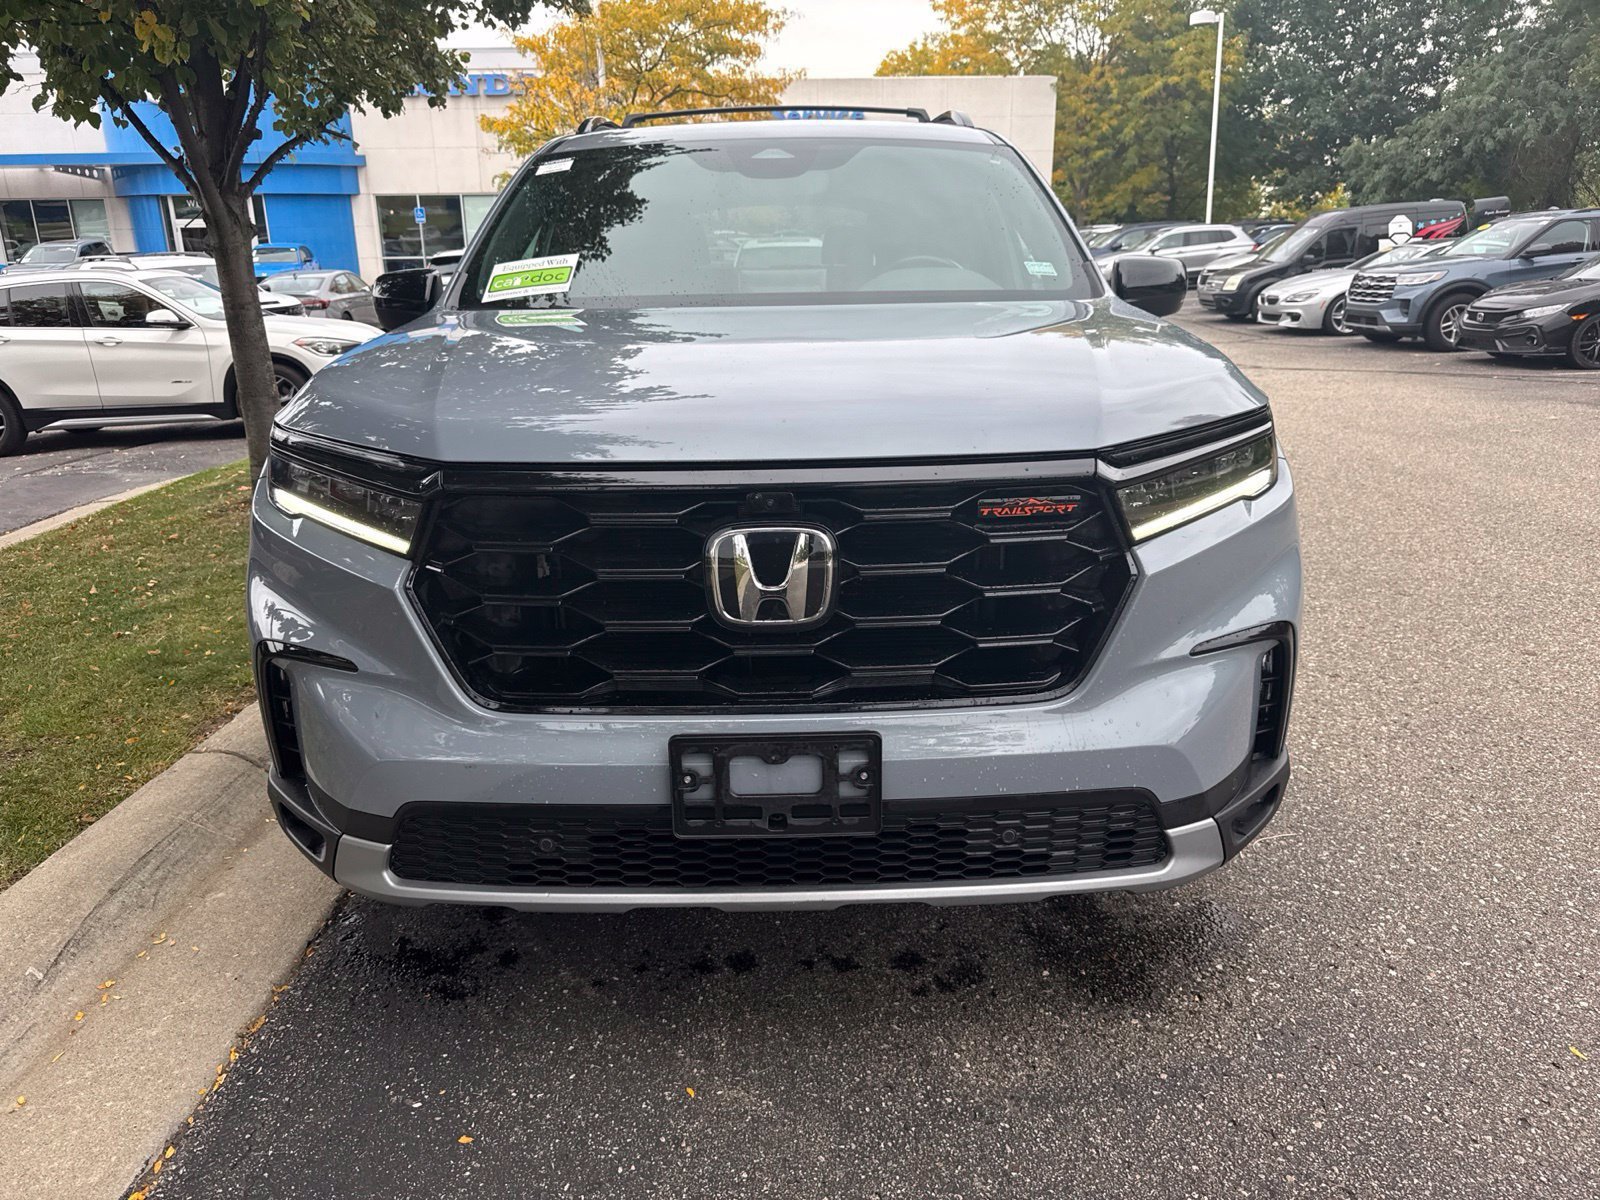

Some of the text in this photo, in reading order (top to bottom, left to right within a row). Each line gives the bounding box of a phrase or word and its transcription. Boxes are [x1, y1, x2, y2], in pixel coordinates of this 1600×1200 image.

[502, 257, 569, 272] Equipped With
[980, 504, 1078, 517] TRAILSPORT
